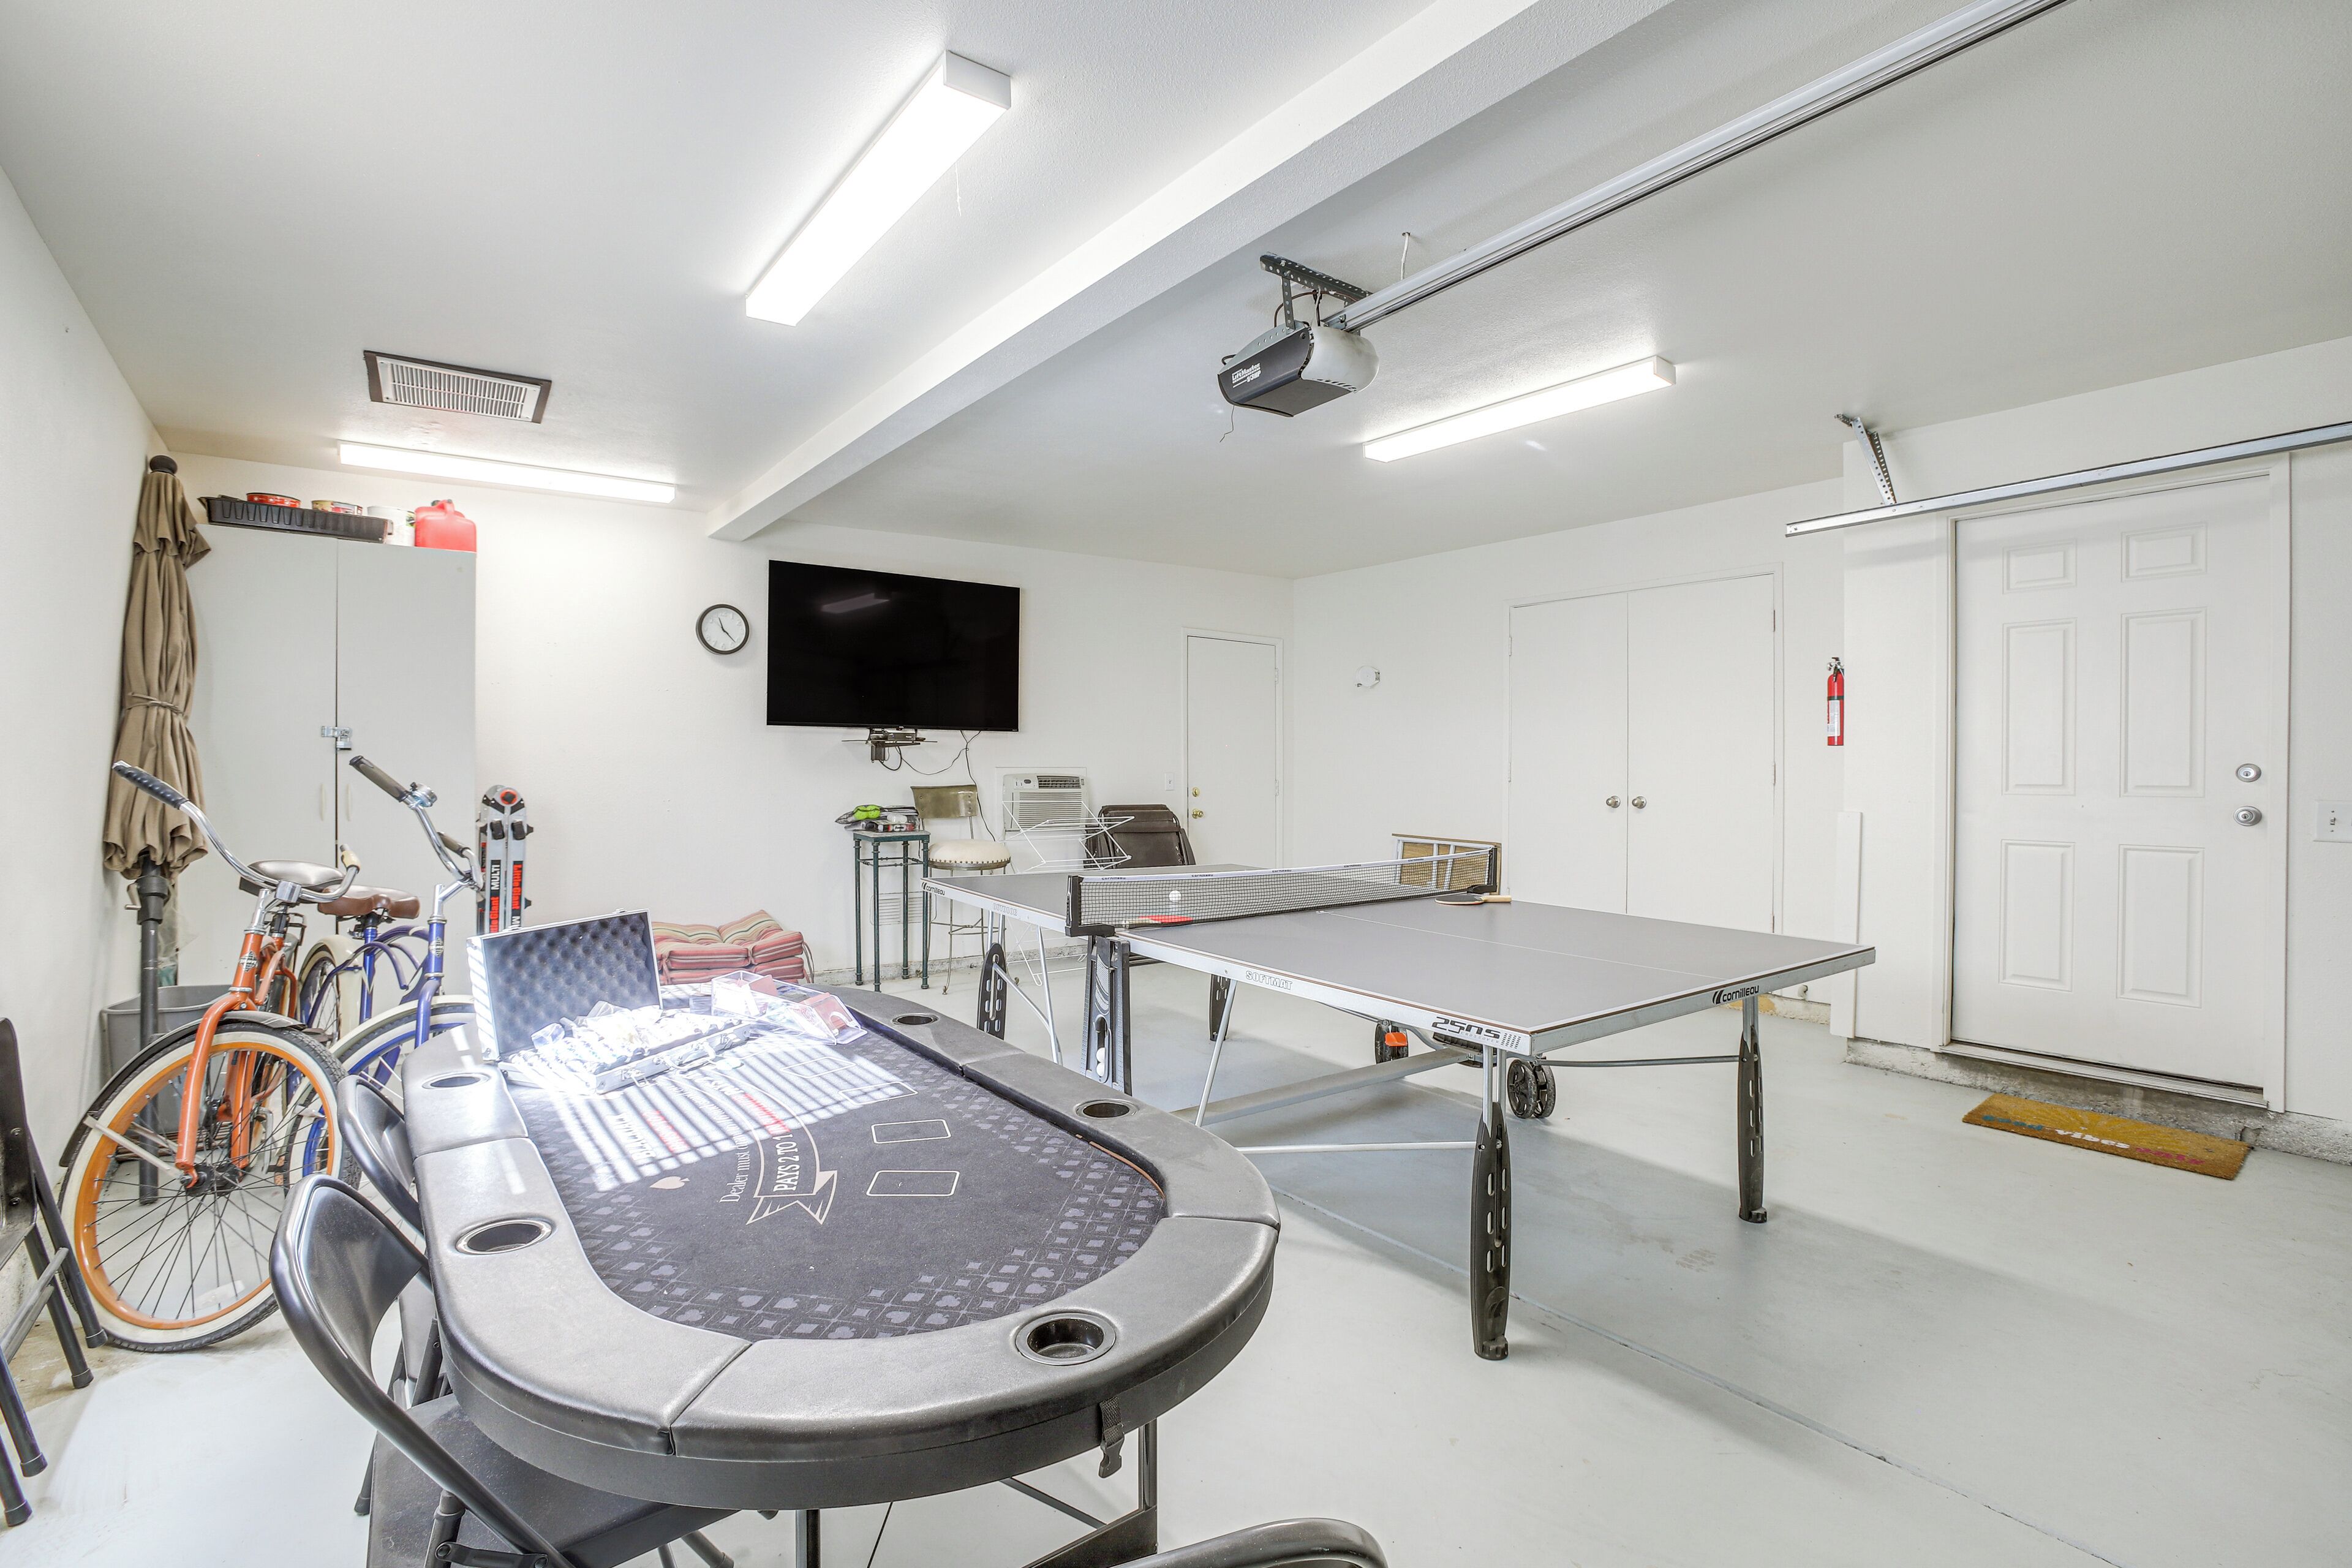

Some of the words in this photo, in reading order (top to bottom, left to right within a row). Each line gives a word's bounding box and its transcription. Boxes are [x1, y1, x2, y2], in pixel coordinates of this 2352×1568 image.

[1232, 363, 1261, 381] LiftMaster
[491, 864, 500, 891] MULTI
[926, 885, 945, 896] cornilleau
[490, 896, 500, 919] Giant
[1245, 970, 1293, 990] SOFTMAT
[1722, 985, 1759, 1003] cornilleau
[1461, 1031, 1499, 1044] CROSSOVER
[605, 1111, 657, 1162] BLACKJACK
[2055, 1126, 2130, 1149] vibes
[775, 1141, 799, 1156] TO
[718, 1173, 748, 1203] Dealer
[735, 1152, 750, 1171] must
[773, 1164, 800, 1192] PAYS
